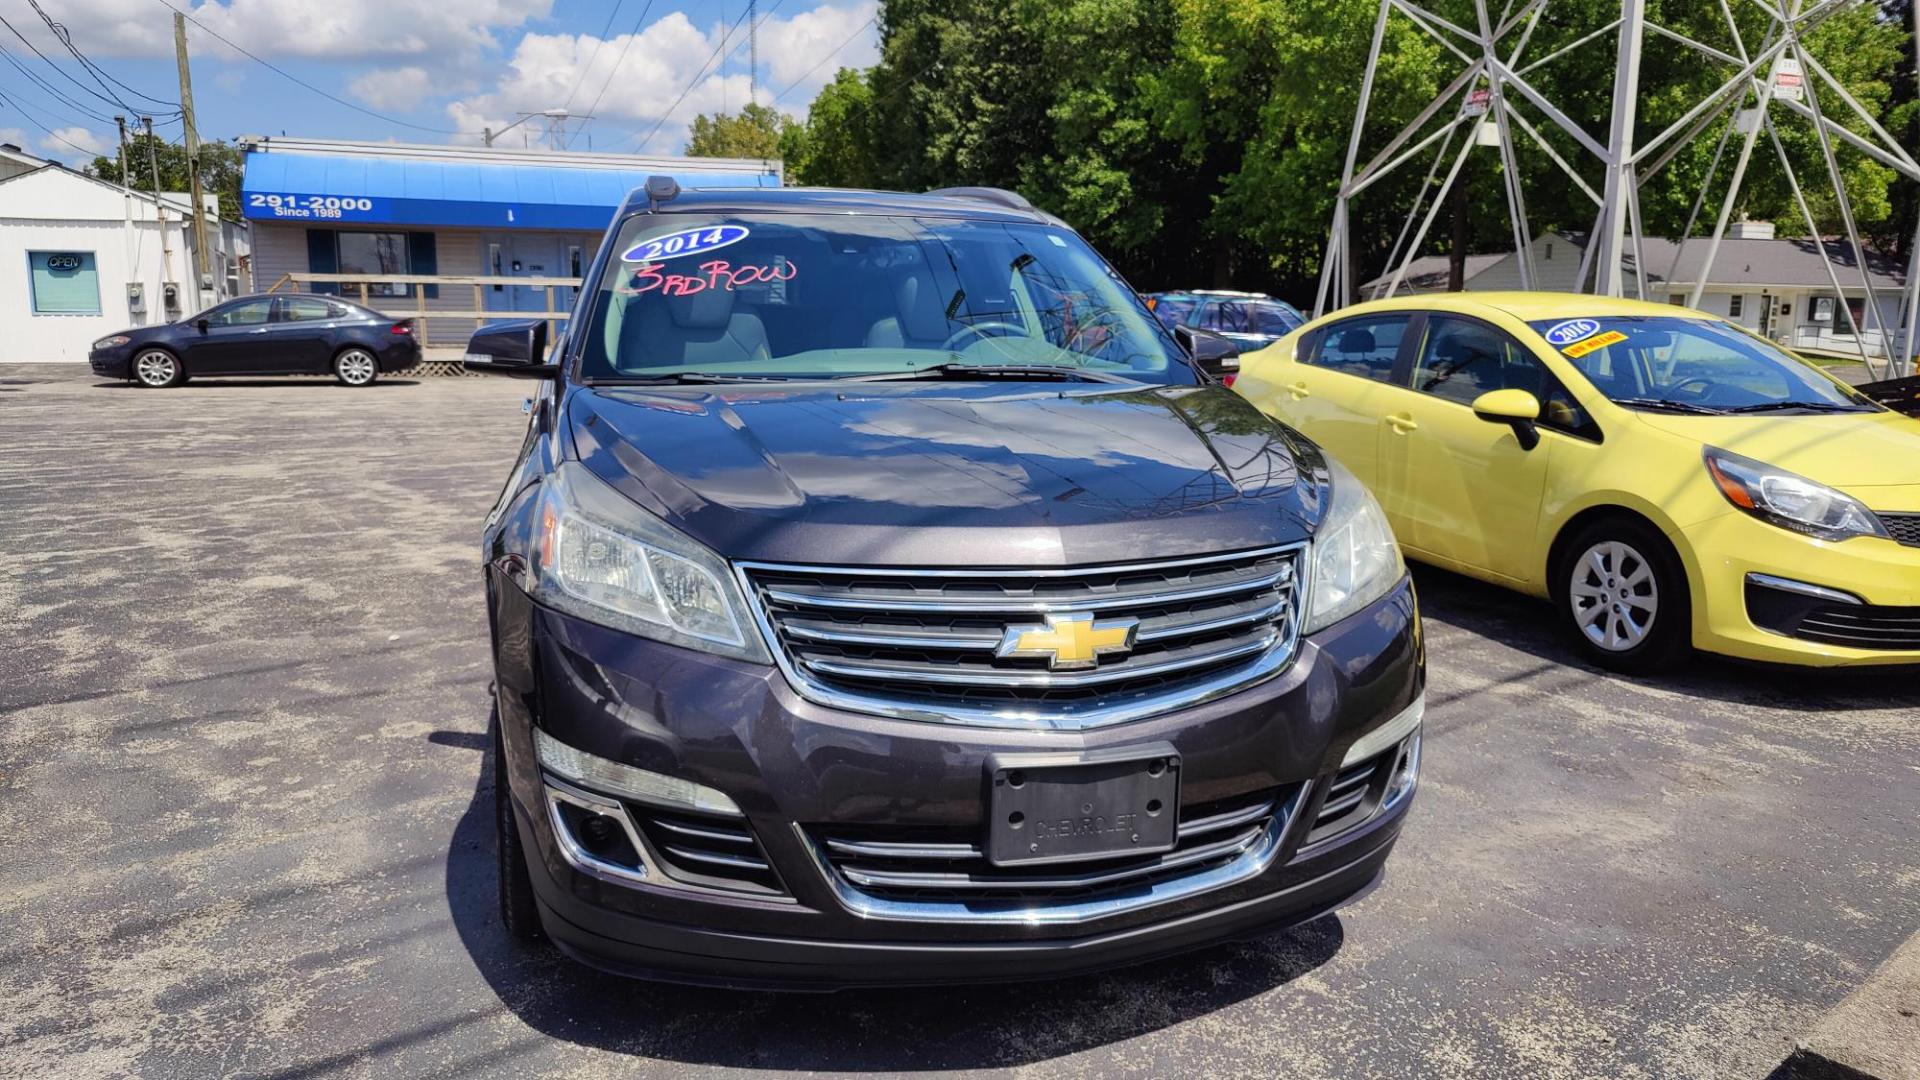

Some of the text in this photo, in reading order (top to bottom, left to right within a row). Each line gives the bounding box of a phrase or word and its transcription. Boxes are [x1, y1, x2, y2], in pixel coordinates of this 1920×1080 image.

[250, 194, 373, 211] 291-2000
[275, 206, 342, 219] Since 1989
[644, 228, 722, 258] 2014
[50, 257, 79, 267] OPEN
[1555, 321, 1591, 342] 2016
[1035, 813, 1138, 839] CHEVROLET
